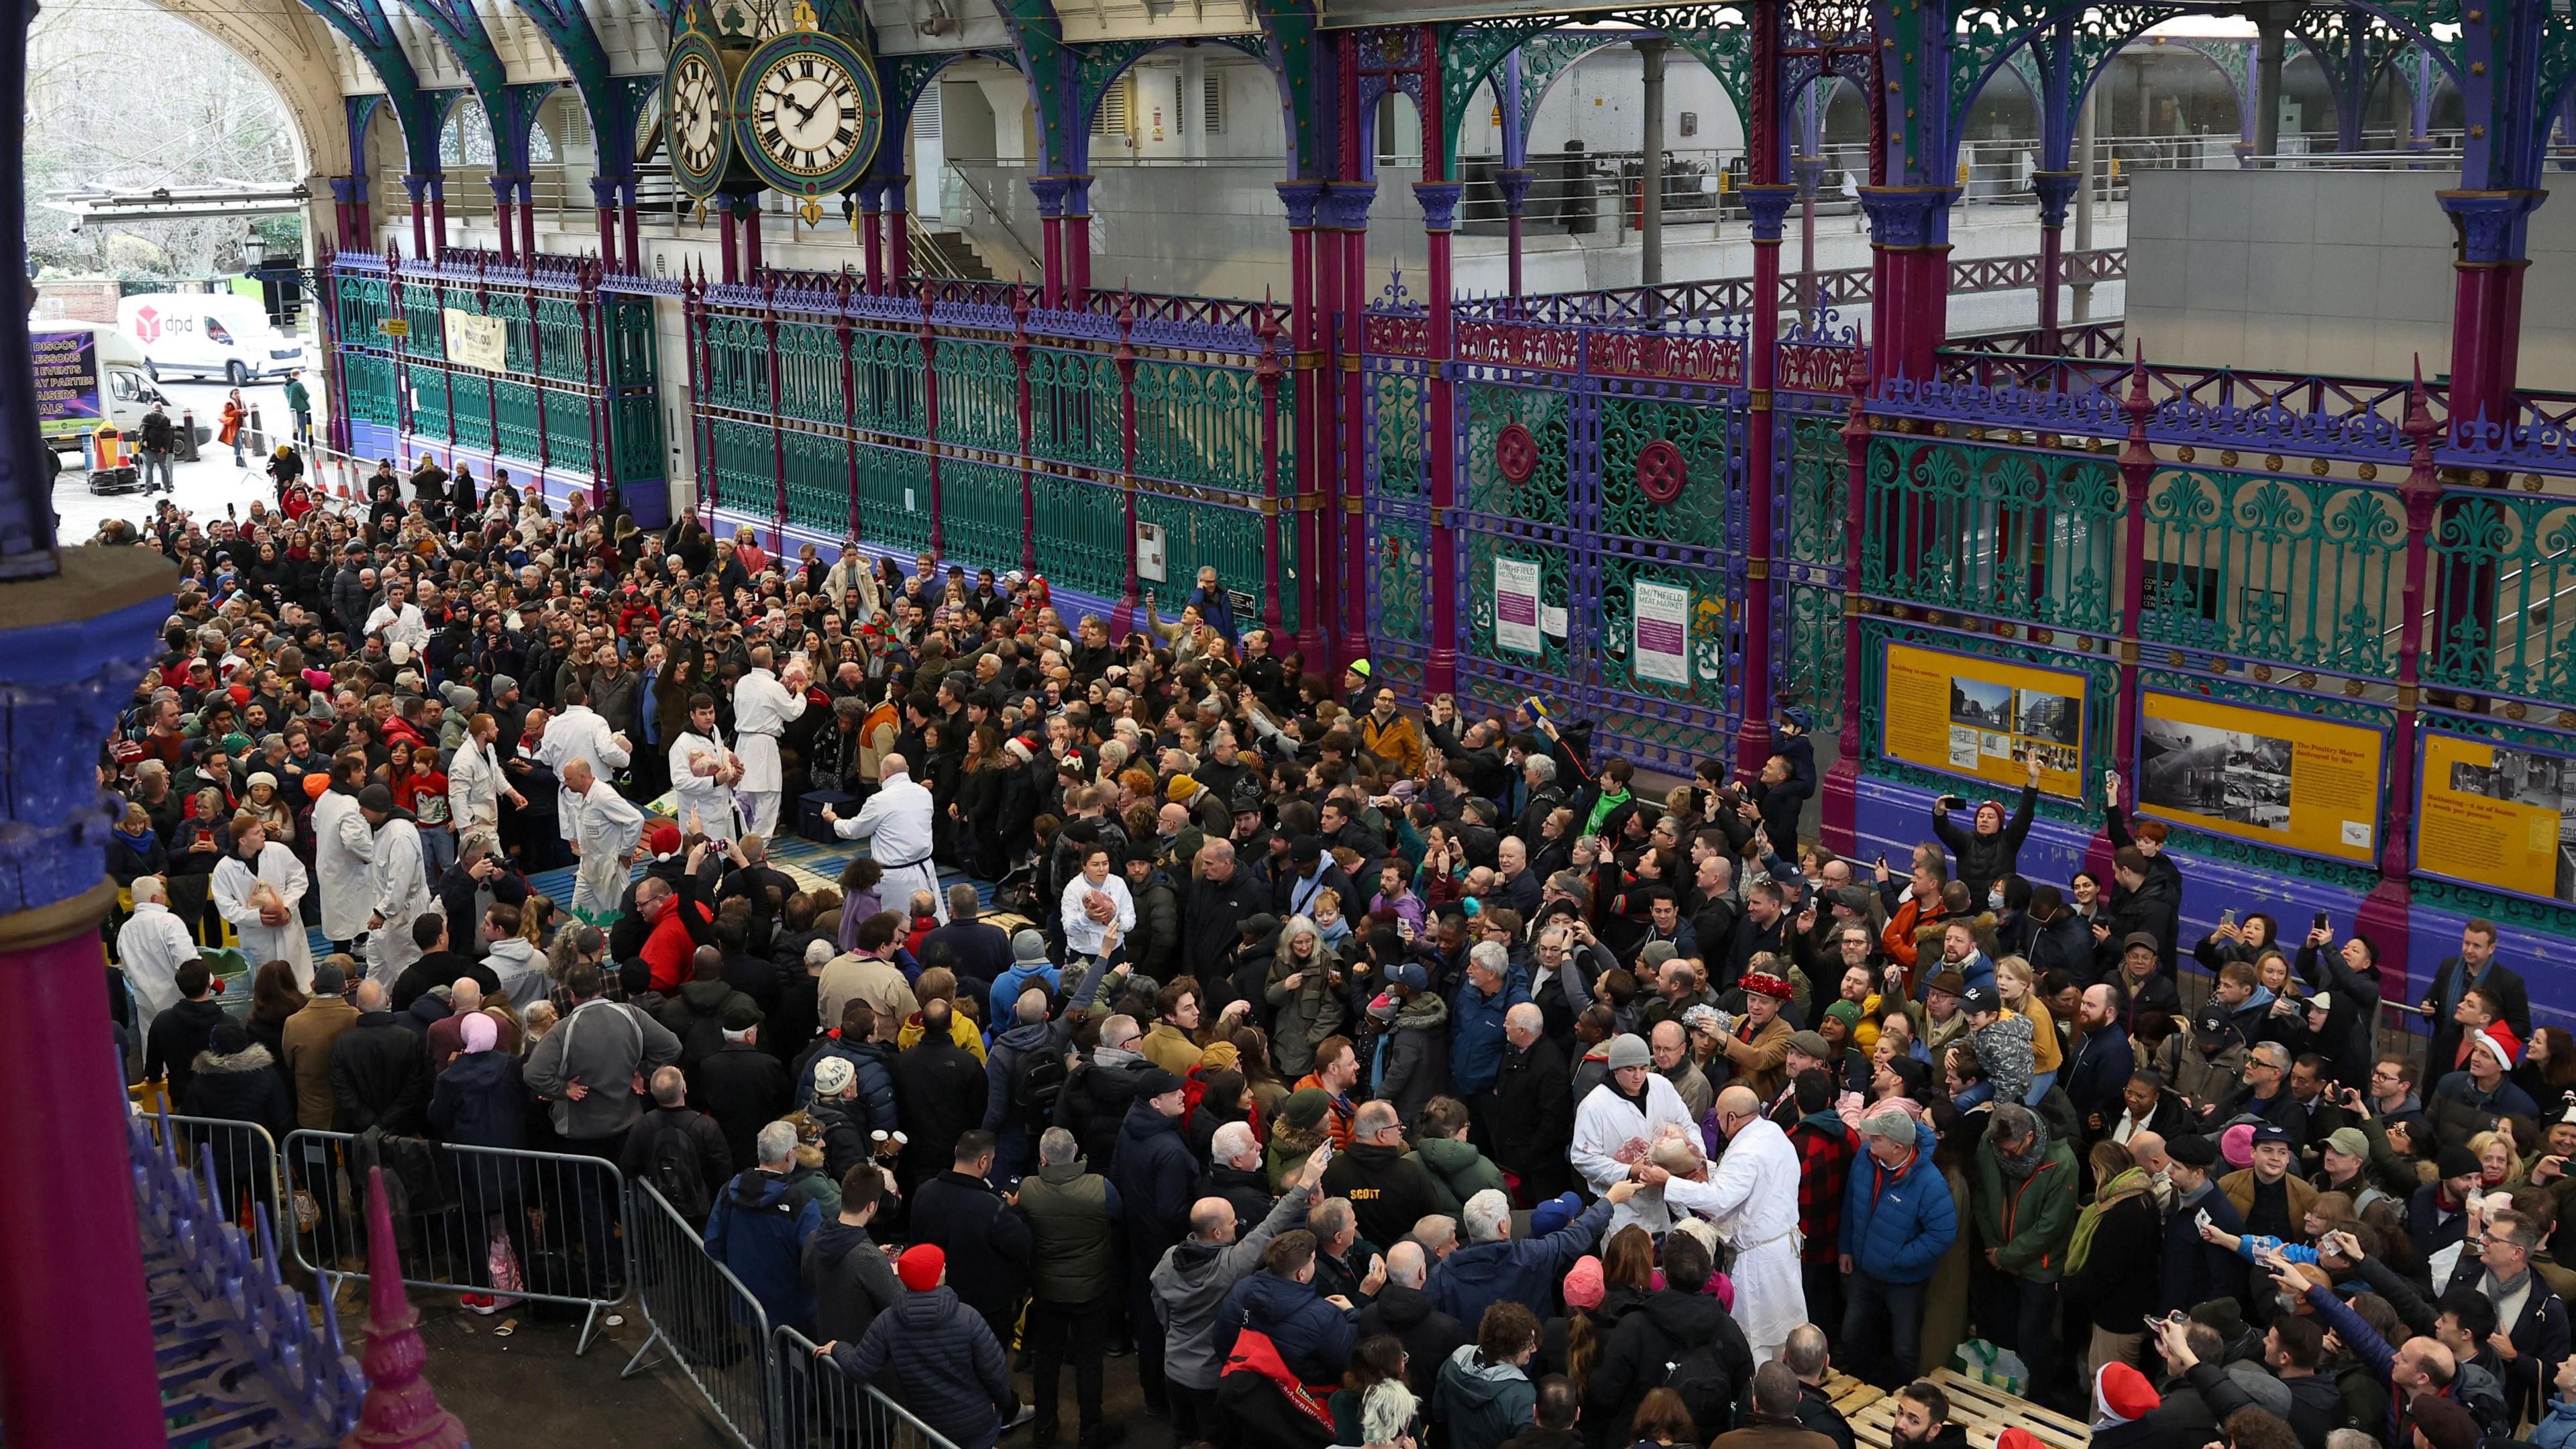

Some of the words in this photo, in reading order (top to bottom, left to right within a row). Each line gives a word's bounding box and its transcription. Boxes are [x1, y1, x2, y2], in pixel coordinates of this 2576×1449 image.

[166, 314, 192, 336] dpd
[34, 340, 77, 352] DISCOS
[41, 365, 81, 376] EVENTS
[34, 379, 49, 388] AY
[50, 376, 95, 386] PARTIES
[36, 389, 77, 400] AISERS
[39, 403, 64, 415] ALS
[1499, 563, 1535, 576] SMITHFIELD
[1639, 587, 1683, 602] SMITHFIELD
[2144, 594, 2170, 604] LONON
[1639, 596, 1655, 604] MEAT
[1656, 599, 1682, 610] MARKET
[2339, 749, 2365, 758] Market
[1350, 1189, 1381, 1200] SCOTT
